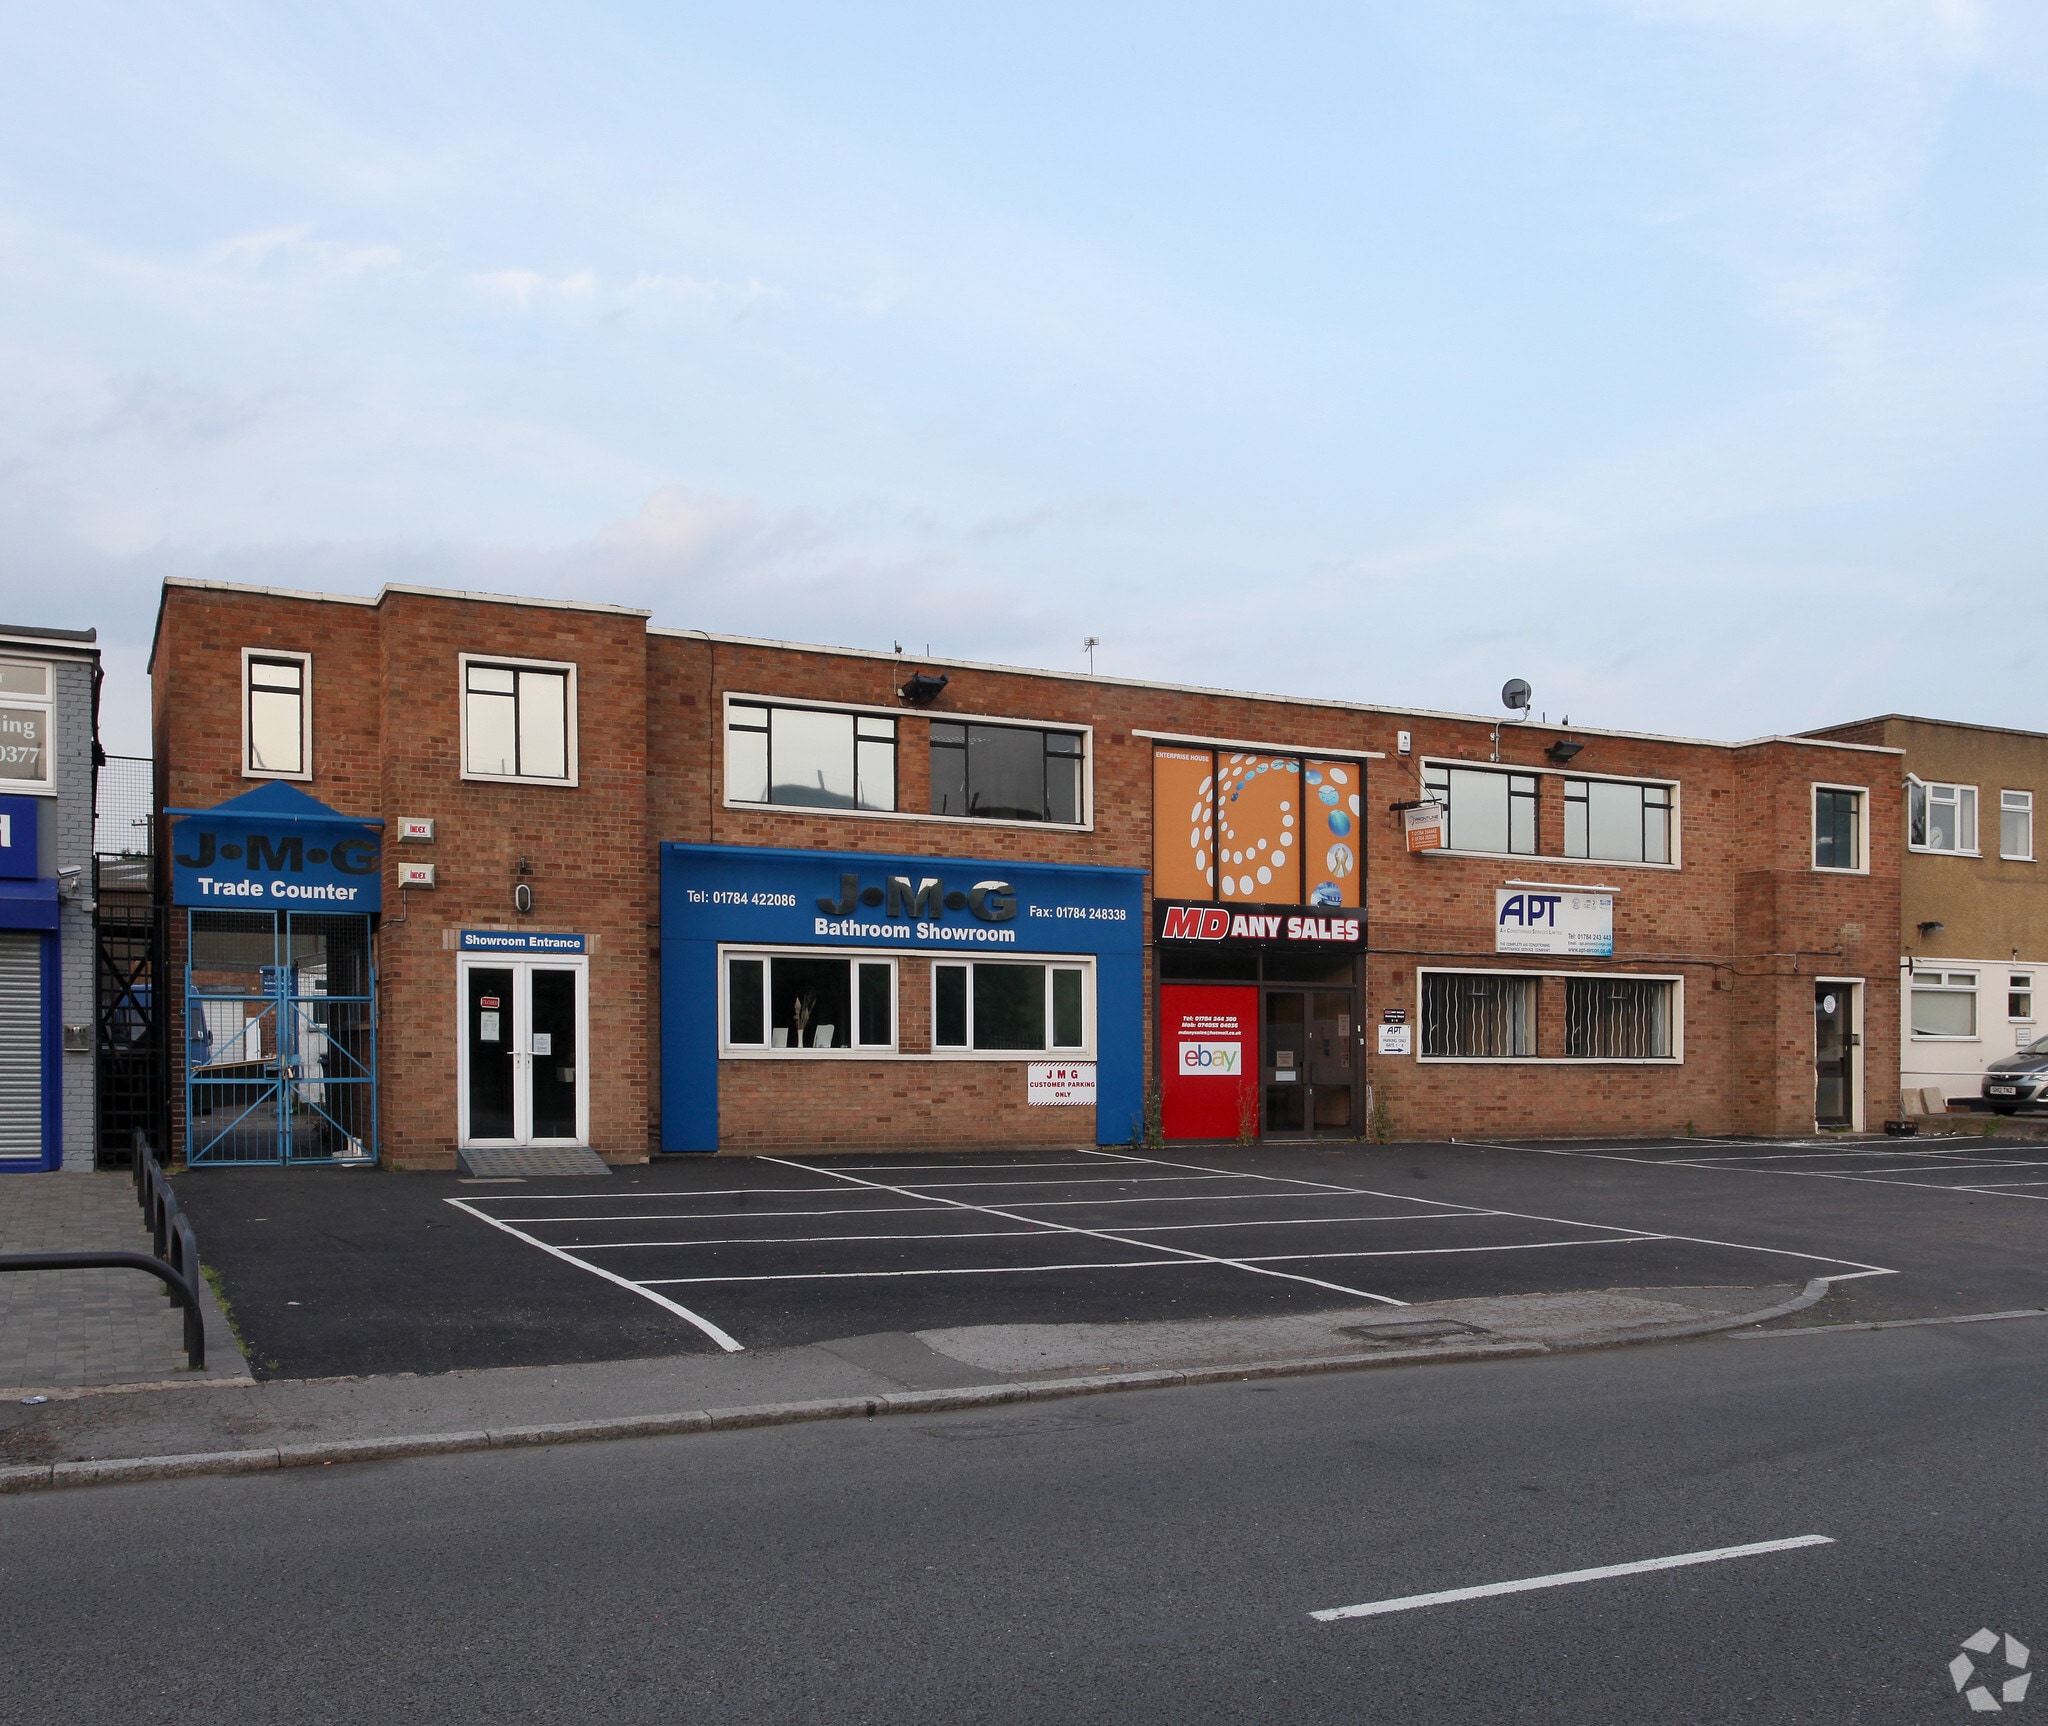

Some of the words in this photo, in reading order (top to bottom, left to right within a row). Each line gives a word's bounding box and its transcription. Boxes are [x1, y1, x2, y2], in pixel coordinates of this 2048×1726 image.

[0, 714, 35, 739] ing
[1155, 751, 1190, 760] ENTERPRISE
[1190, 754, 1209, 762] HOUSE
[198, 878, 264, 897] Trade
[270, 880, 358, 900] Counter
[687, 889, 709, 903] Tel:
[713, 891, 748, 905] 01784
[751, 893, 796, 906] 422086
[1029, 905, 1053, 918] Fax:
[1056, 906, 1087, 919] 01784
[1089, 908, 1126, 921] 248338
[1499, 894, 1561, 927] APT
[814, 918, 910, 938] Bathroom
[916, 922, 1015, 942] Showroom
[1162, 907, 1230, 940] MD
[1230, 914, 1282, 938] ANY
[1288, 917, 1360, 941] SALES
[465, 934, 526, 947] Showroom
[529, 936, 581, 948] Entrance
[1387, 1026, 1402, 1034] APT
[1185, 1044, 1238, 1072] ebay
